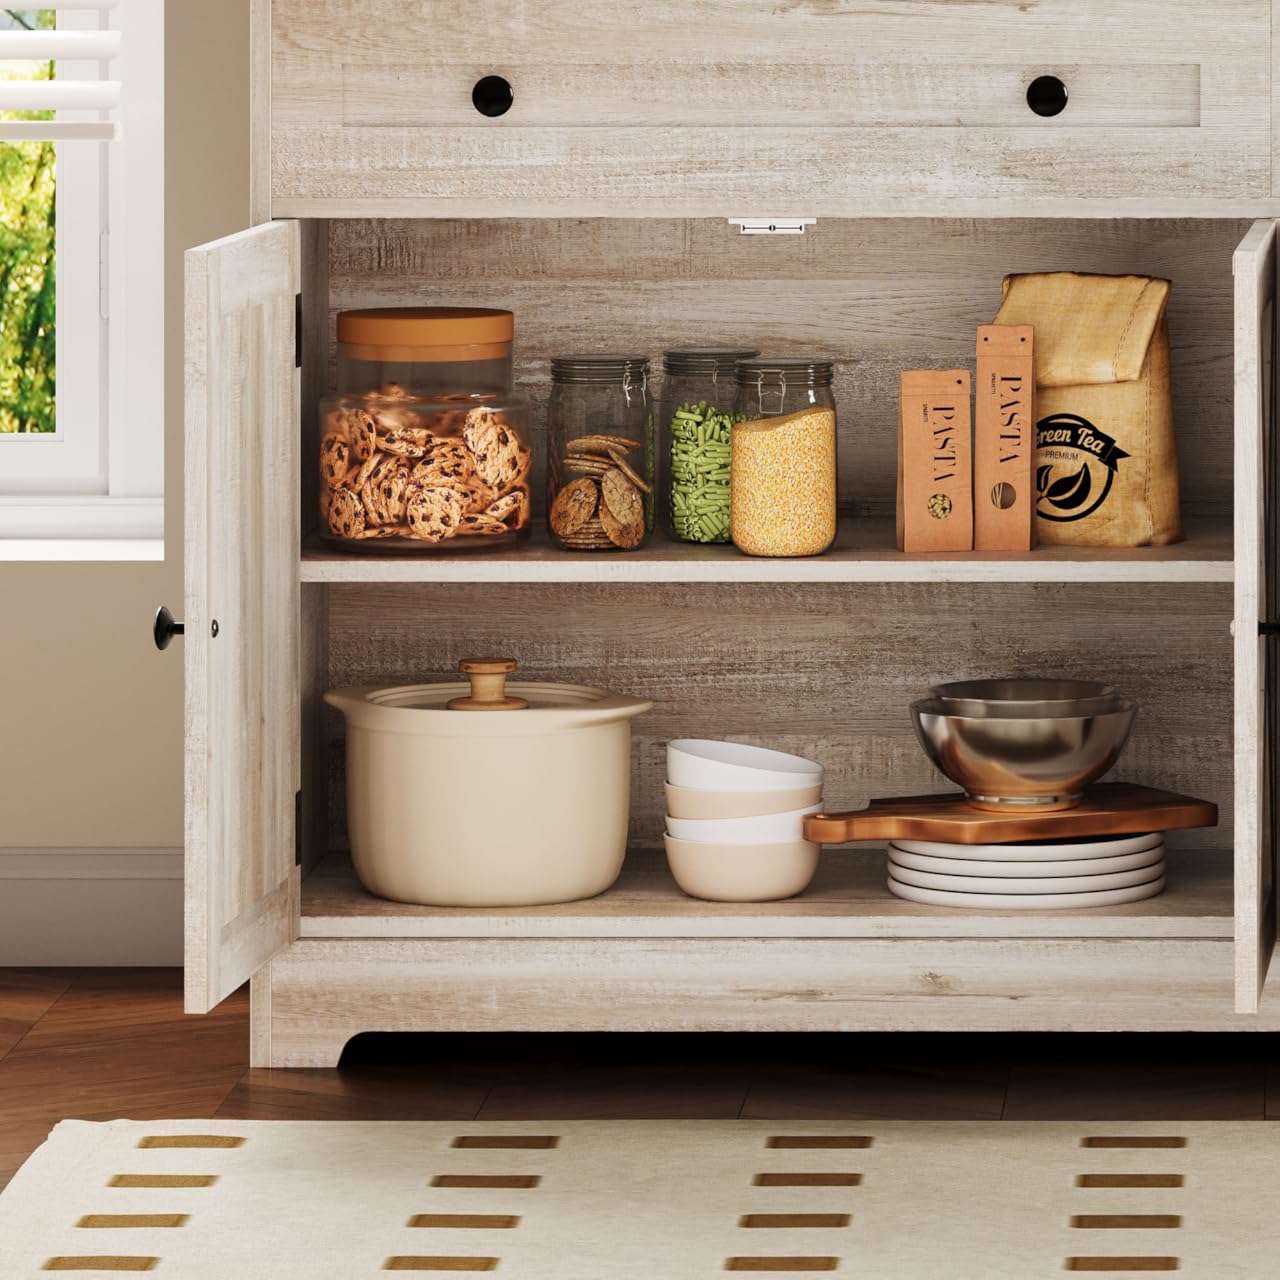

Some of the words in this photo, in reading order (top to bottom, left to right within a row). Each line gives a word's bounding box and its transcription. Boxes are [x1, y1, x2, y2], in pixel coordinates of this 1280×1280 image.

[932, 406, 957, 481] PASTA
[999, 376, 1022, 463] PASTA
[1077, 427, 1105, 453] Tea
[1045, 450, 1080, 461] PREMIUM
